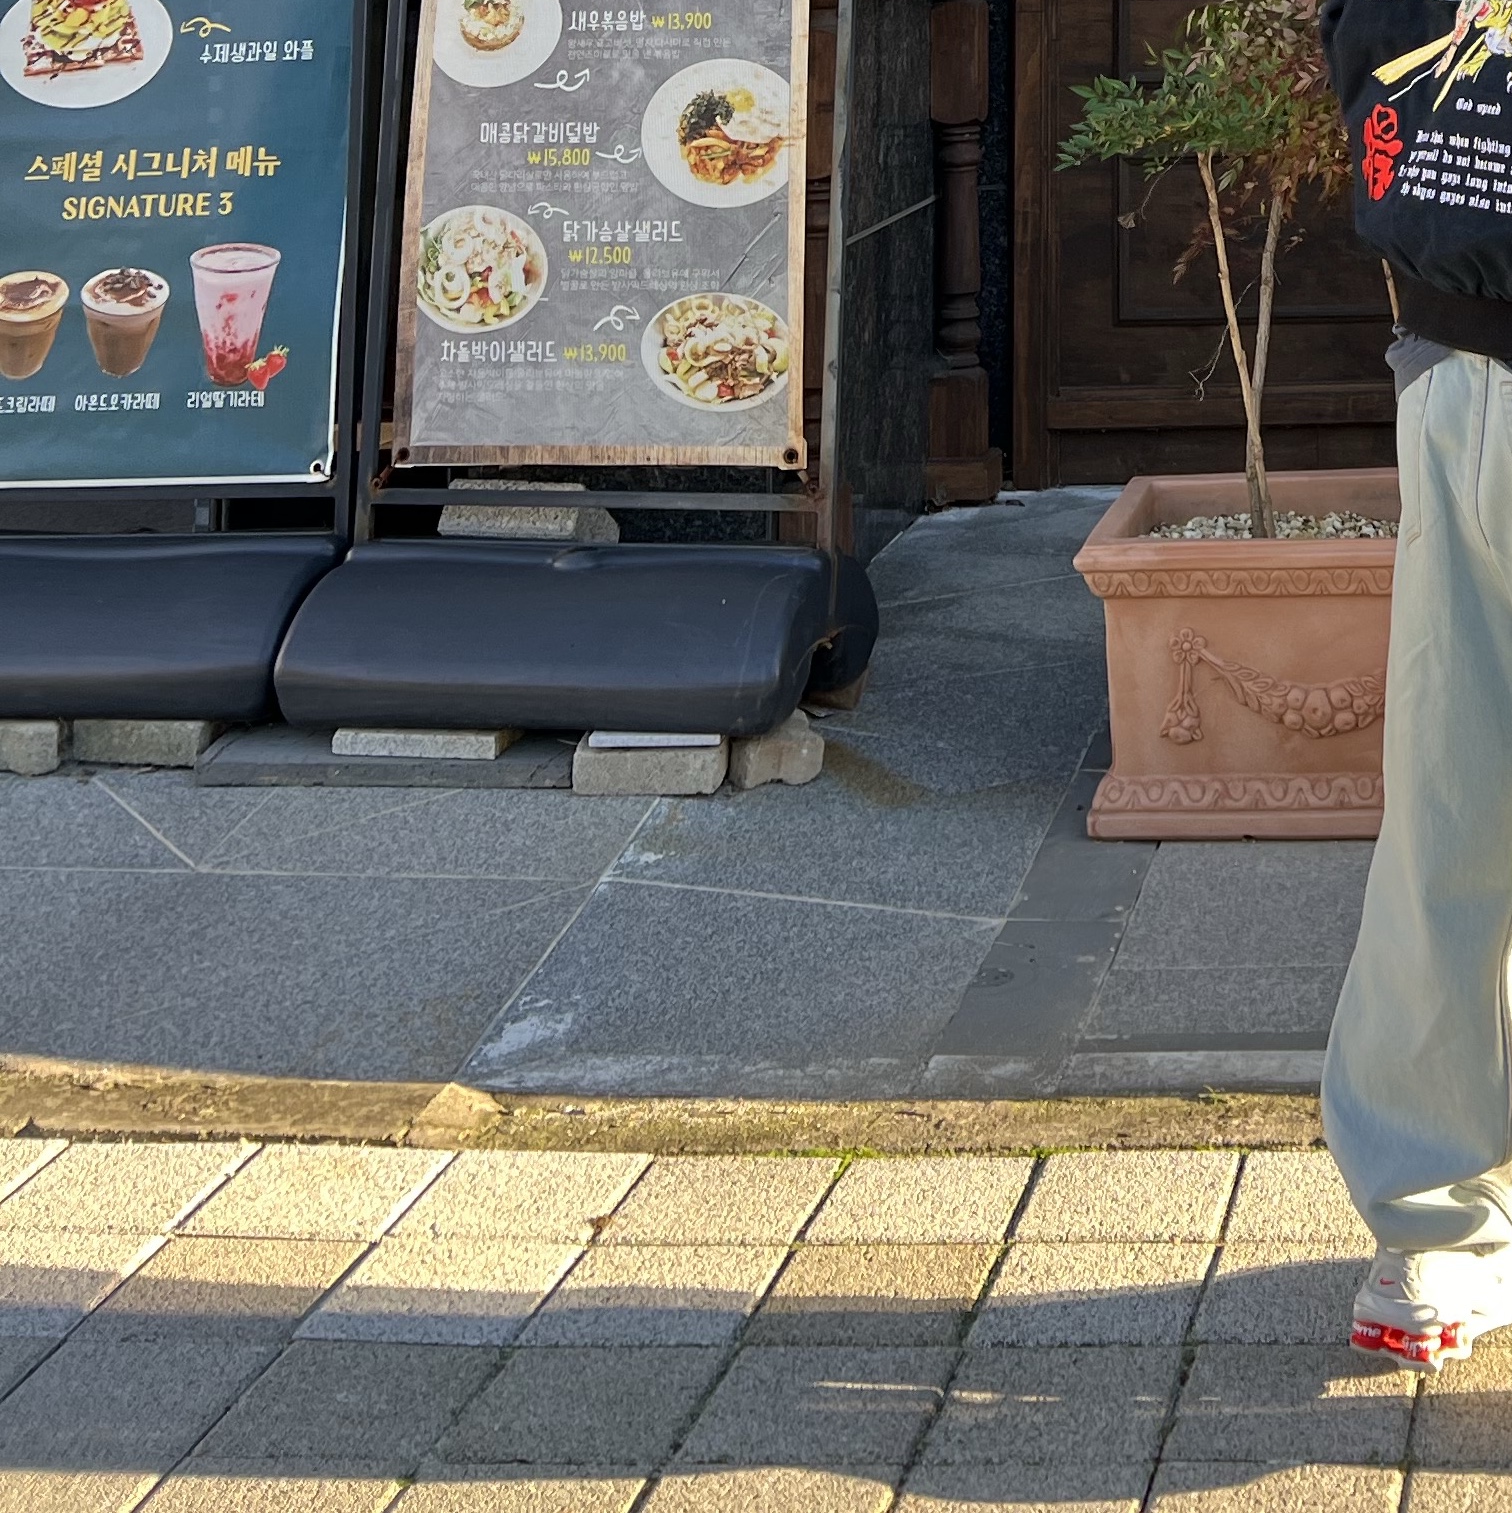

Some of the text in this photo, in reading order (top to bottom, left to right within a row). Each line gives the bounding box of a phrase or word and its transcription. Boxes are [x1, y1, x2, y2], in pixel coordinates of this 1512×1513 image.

[568, 10, 646, 32] 새우볶음밥
[199, 40, 315, 65] 수제생과일 와플
[480, 121, 600, 144] 매콤닭갈비덮밥
[24, 145, 282, 183] 스페셜 시그니처 메뉴
[61, 191, 234, 222] SIGNATURE 3
[562, 220, 684, 243] 닭가슴살샐러드
[440, 339, 558, 363] 차돌박이샐러드
